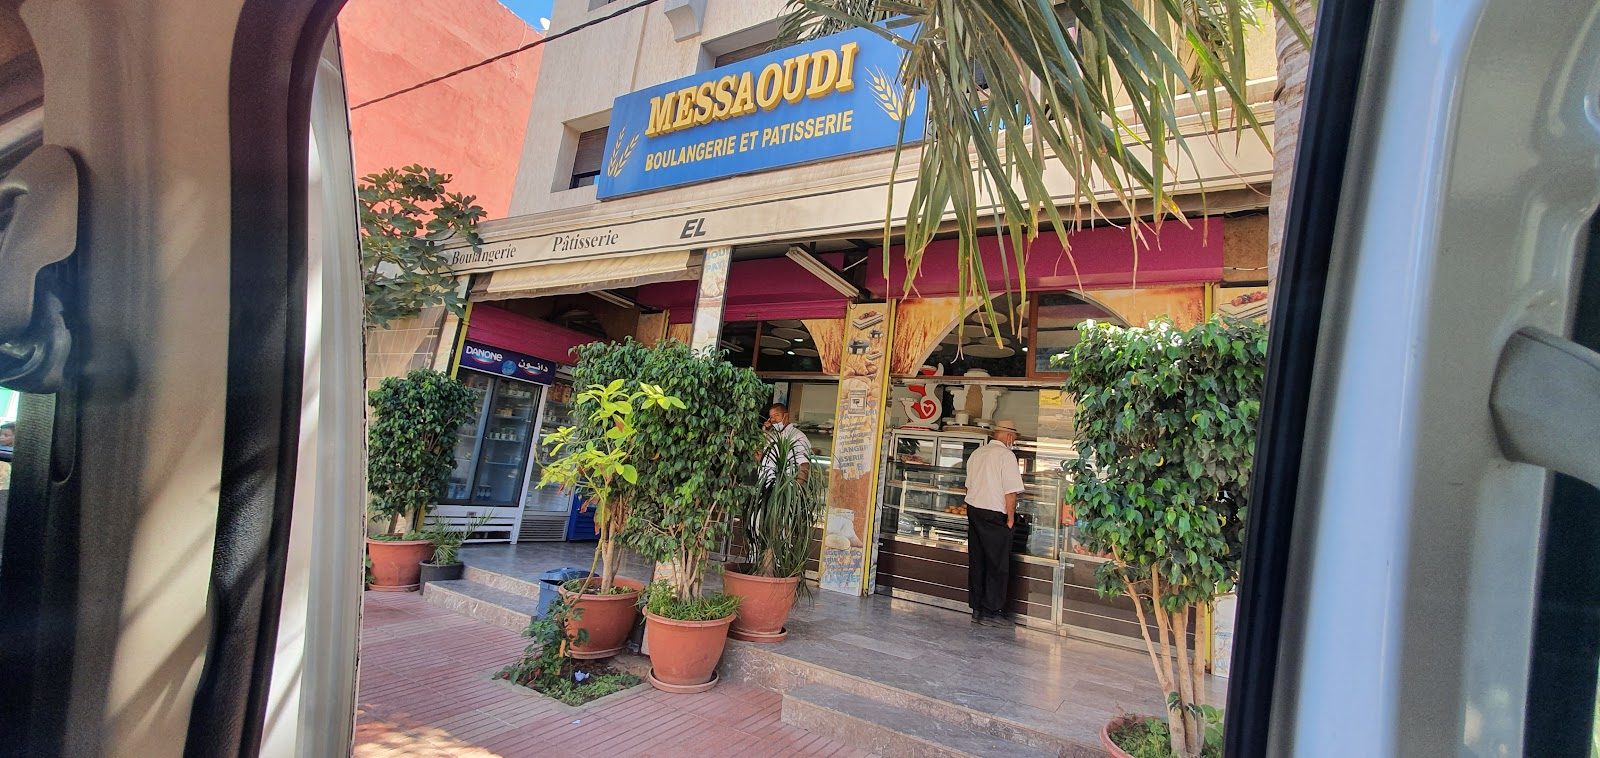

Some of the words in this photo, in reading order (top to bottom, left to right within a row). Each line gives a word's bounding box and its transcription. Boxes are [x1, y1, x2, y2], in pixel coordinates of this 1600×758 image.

[645, 42, 859, 138] MESSAOUDI
[645, 136, 736, 171] BOULANGERIE
[739, 132, 757, 152] ET
[761, 110, 854, 147] PATISSERIE
[552, 230, 619, 251] Pâtisserie
[680, 217, 706, 239] EL
